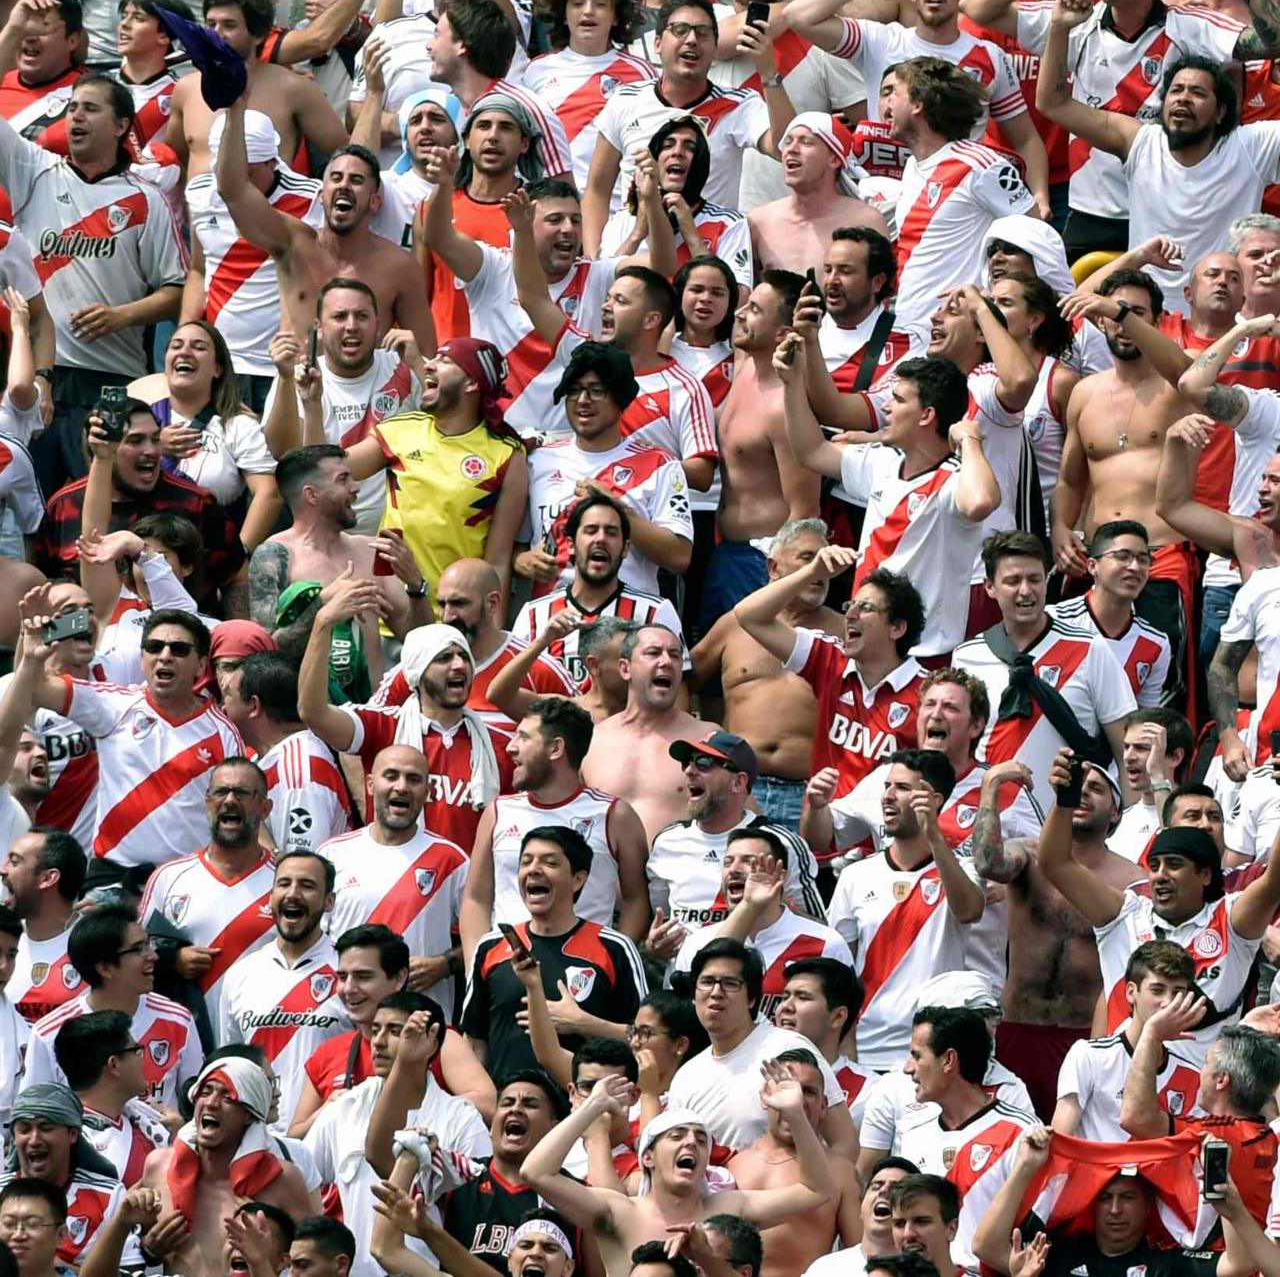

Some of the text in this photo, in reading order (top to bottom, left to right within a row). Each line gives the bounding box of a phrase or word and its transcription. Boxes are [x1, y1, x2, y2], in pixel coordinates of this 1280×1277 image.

[855, 125, 891, 138] FINAL
[38, 227, 118, 261] Quilmes
[242, 1008, 338, 1030] Budweiser
